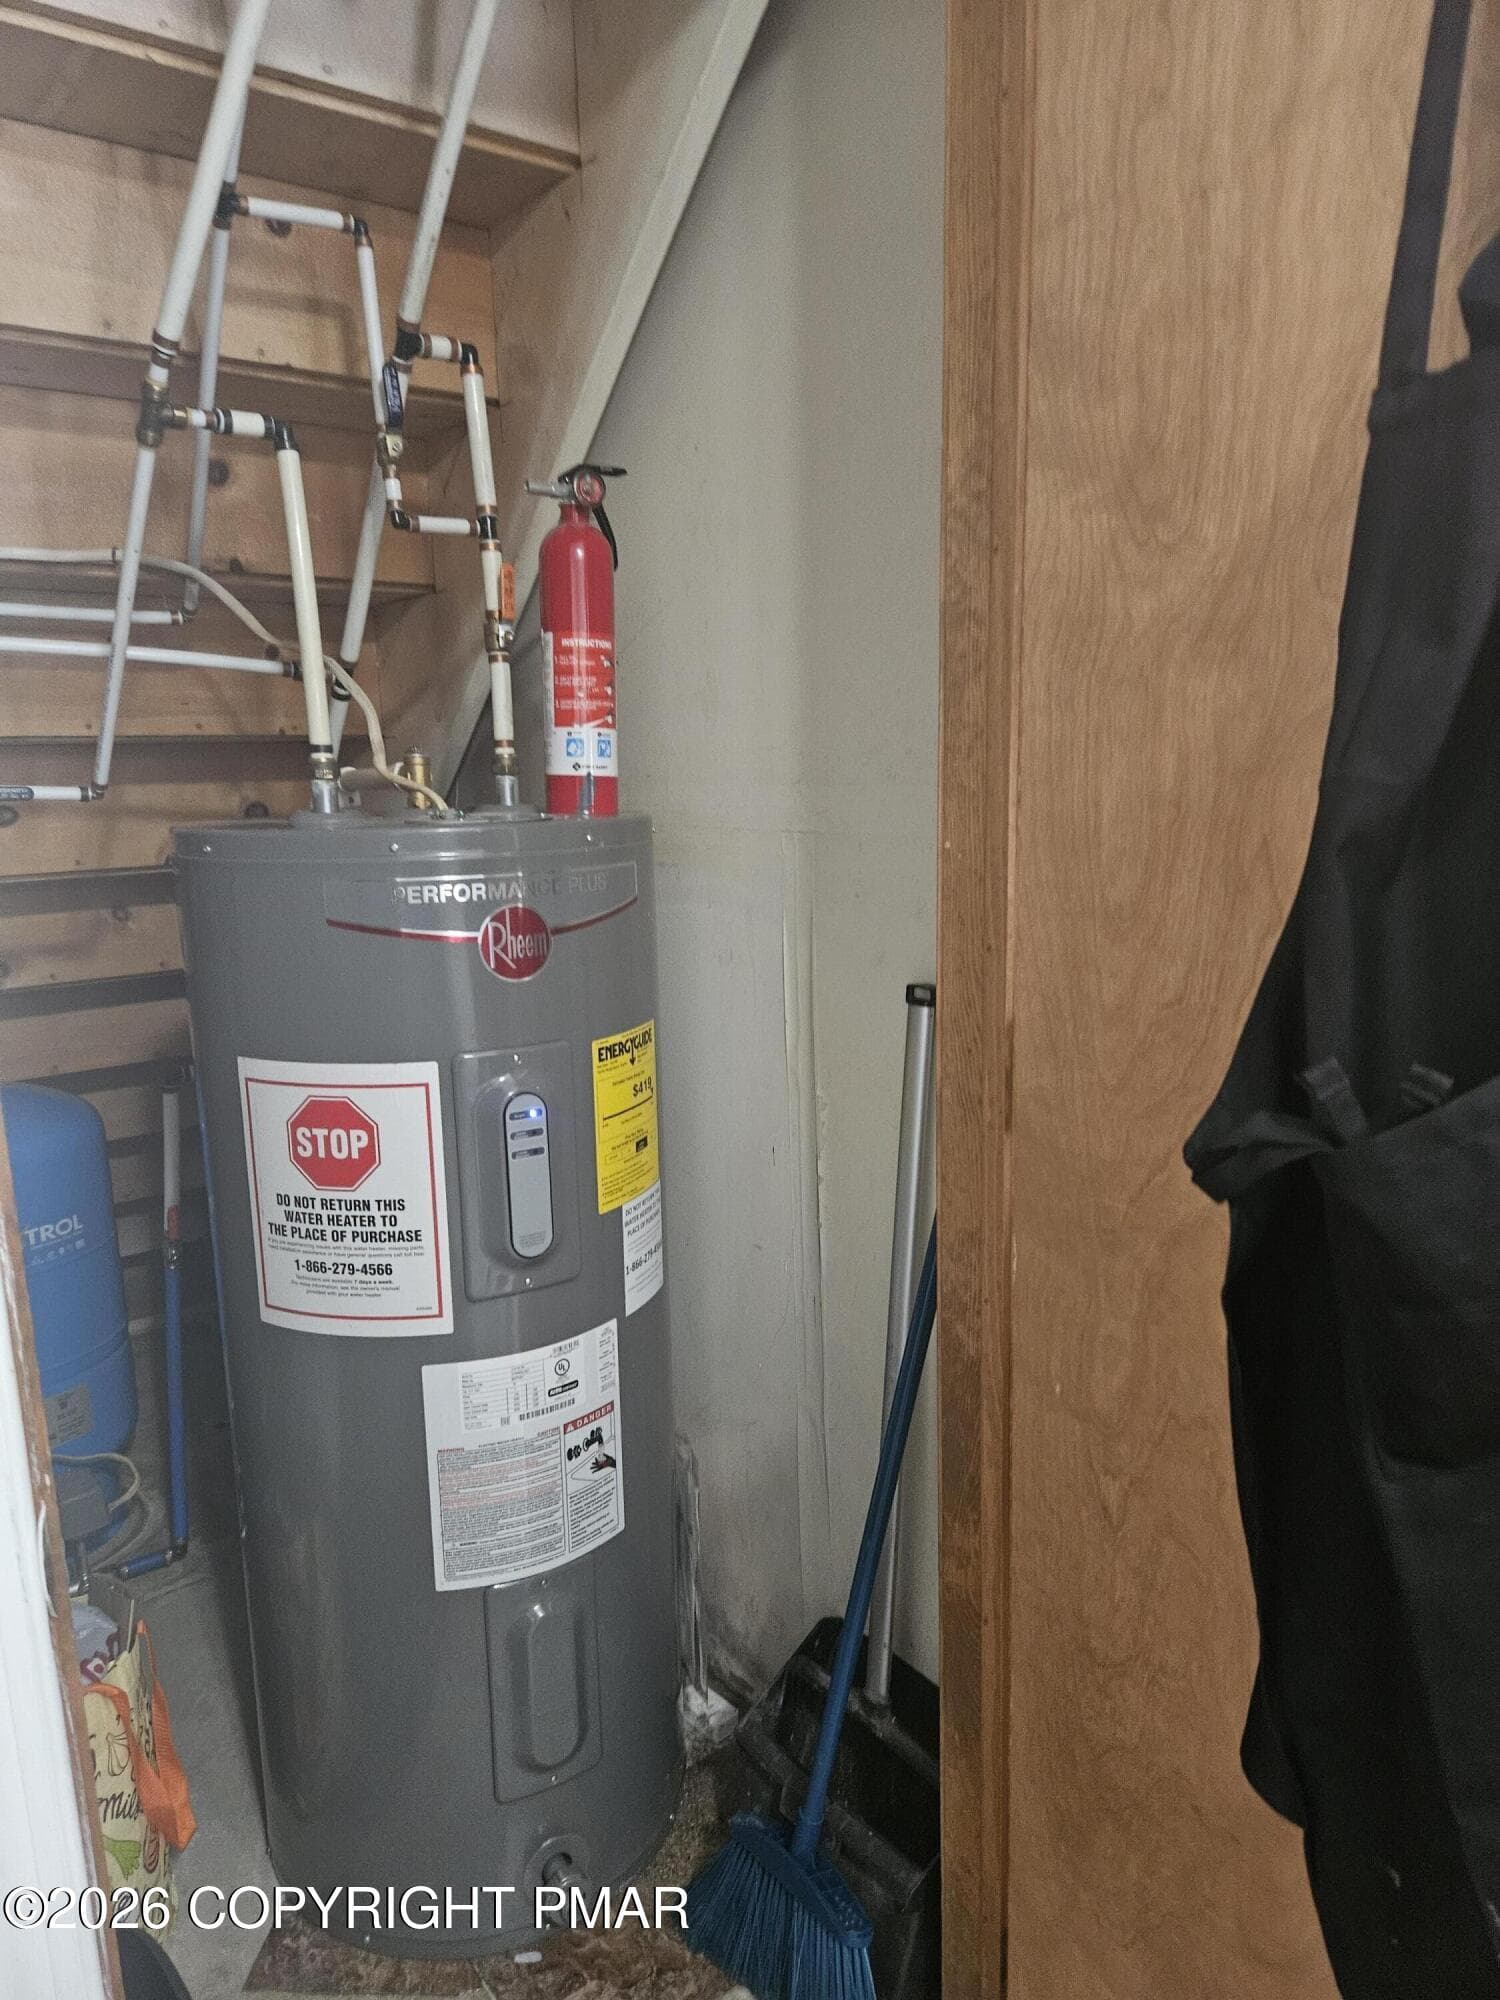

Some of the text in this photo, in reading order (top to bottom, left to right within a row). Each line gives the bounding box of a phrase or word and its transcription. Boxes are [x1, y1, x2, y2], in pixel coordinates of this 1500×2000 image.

[487, 908, 548, 969] Rheem
[296, 1127, 368, 1160] STOP
[276, 1193, 406, 1212] DO NOT RETURN THIS
[284, 1209, 398, 1227] WATER HEATER TO
[24, 1214, 83, 1246] TROL
[268, 1222, 422, 1243] THE PLACE OF PURCHASE
[294, 1259, 393, 1276] 1-866-279-4566
[576, 1404, 612, 1428] DANGER
